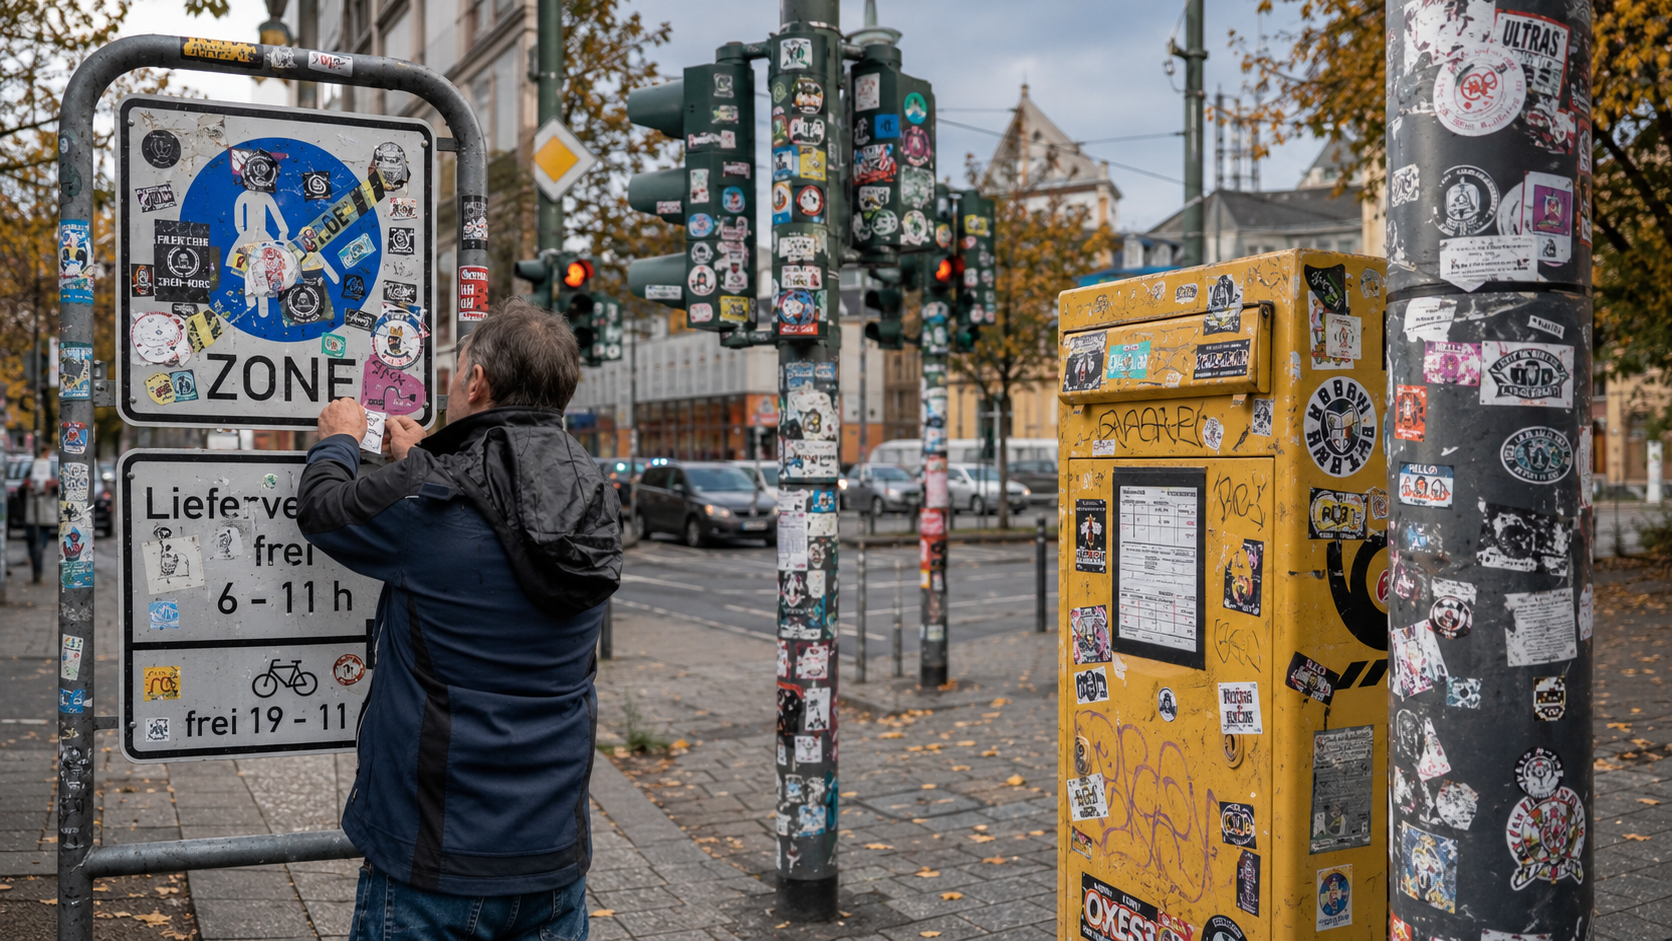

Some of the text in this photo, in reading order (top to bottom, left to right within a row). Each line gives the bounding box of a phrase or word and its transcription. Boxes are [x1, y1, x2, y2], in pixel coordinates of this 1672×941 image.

[1502, 19, 1560, 58] ULTRAS
[206, 353, 357, 402] ZONE
[254, 535, 313, 567] frei
[217, 582, 238, 615] 6
[282, 581, 315, 614] 11
[333, 580, 353, 612] h
[185, 708, 238, 738] frei
[250, 706, 284, 734] 19
[320, 703, 347, 731] 11
